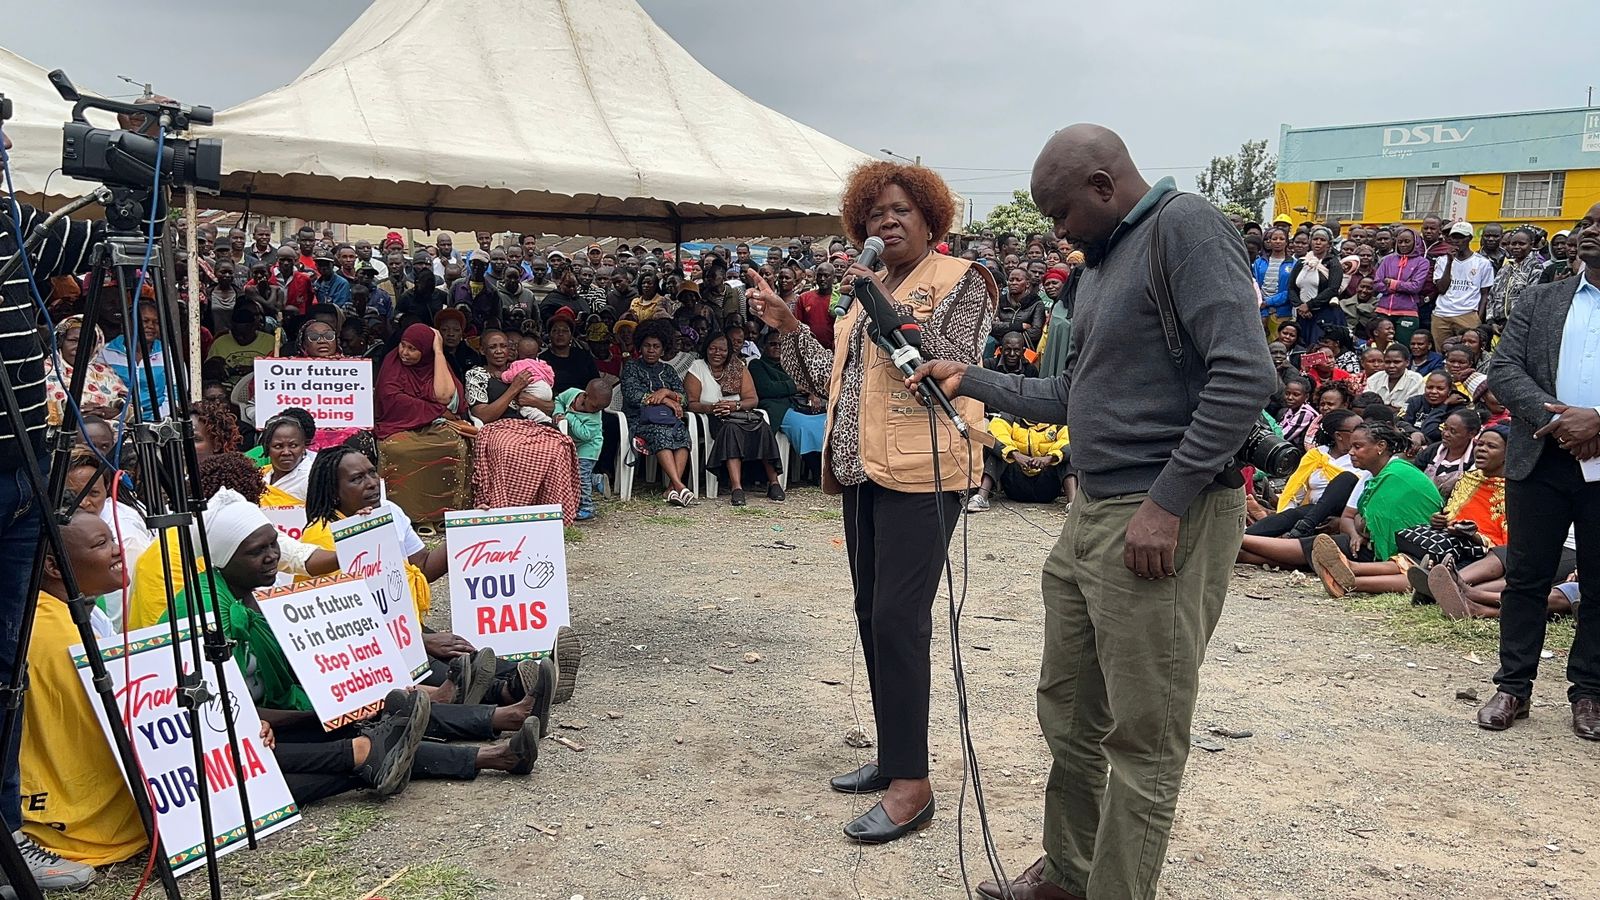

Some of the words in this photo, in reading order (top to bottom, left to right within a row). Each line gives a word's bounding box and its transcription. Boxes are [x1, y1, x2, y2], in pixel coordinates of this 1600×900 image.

[1383, 125, 1474, 146] DStv
[1382, 148, 1412, 159] Kenya
[264, 380, 275, 390] is
[281, 380, 296, 390] in
[301, 380, 365, 392] danger.
[270, 364, 302, 376] Our
[307, 364, 358, 376] future
[276, 394, 312, 407] Stop
[317, 394, 354, 405] land
[455, 535, 527, 572] Thank
[464, 574, 516, 600] YOU
[283, 603, 315, 624] Our
[316, 591, 364, 616] future
[476, 601, 548, 635] RAIS
[288, 632, 306, 652] is
[306, 627, 325, 648] in
[326, 614, 380, 643] danger.
[314, 651, 351, 674] Stop
[351, 636, 383, 663] land
[330, 664, 394, 703] grabbing
[137, 710, 194, 751] YOU
